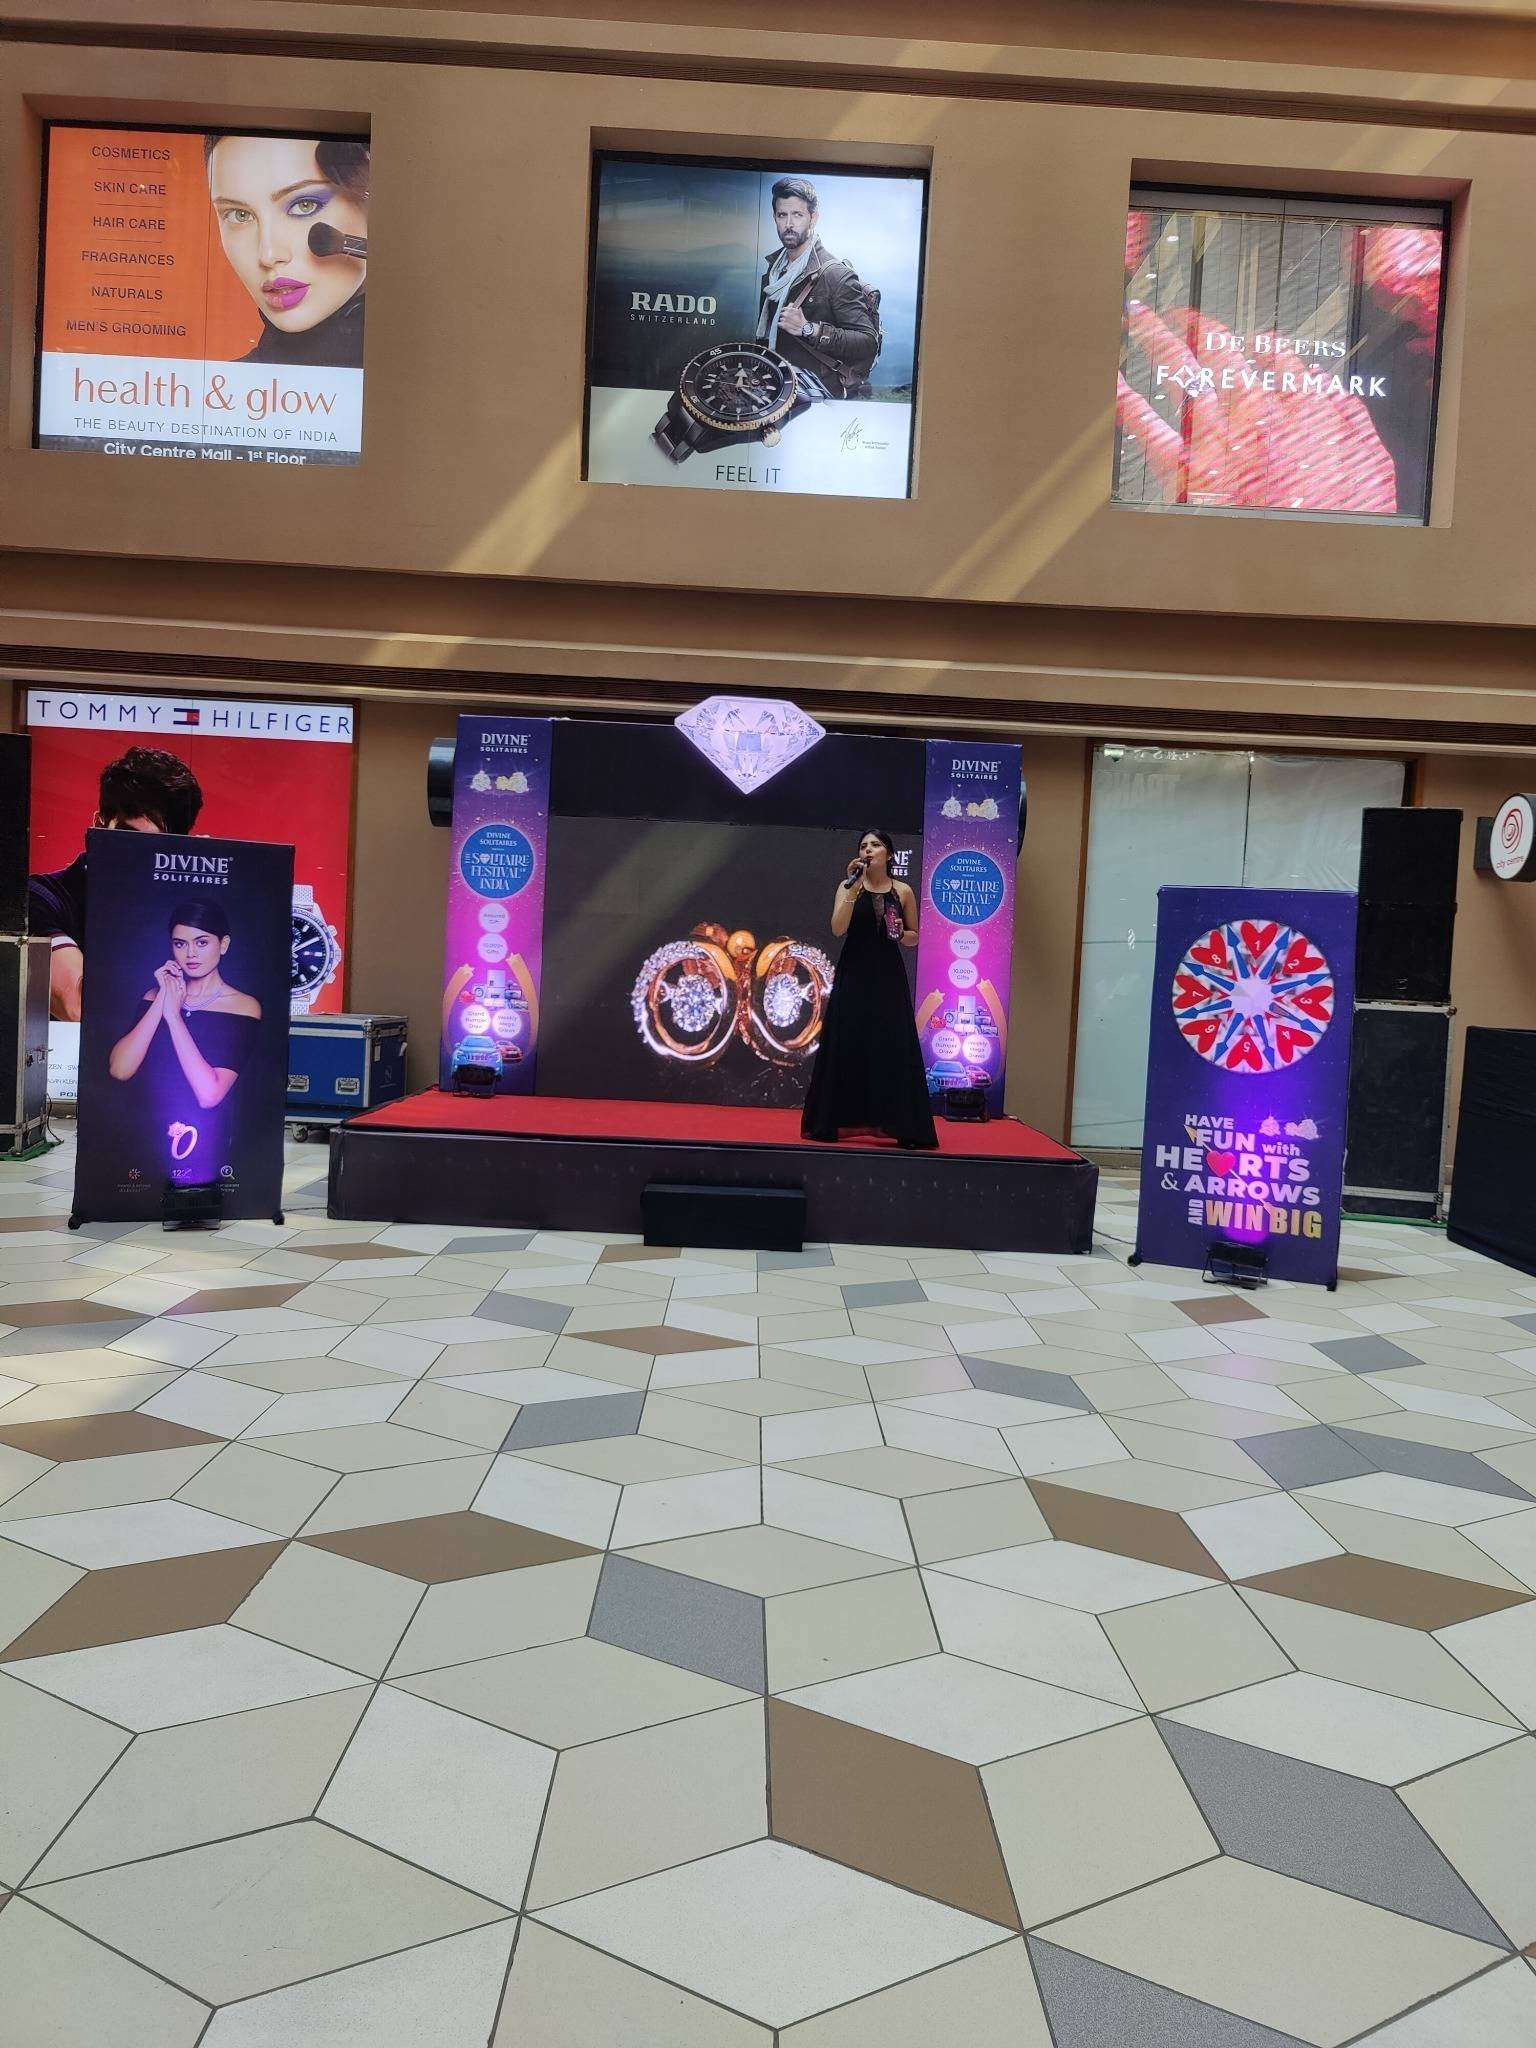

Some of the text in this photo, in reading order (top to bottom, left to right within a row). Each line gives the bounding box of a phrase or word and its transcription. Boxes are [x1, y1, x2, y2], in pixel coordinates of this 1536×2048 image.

[92, 146, 170, 161] COSMETICS
[94, 181, 166, 195] SKIN CARE
[93, 216, 166, 230] HAIR CARE
[81, 250, 175, 265] FRAGRANCES
[91, 286, 163, 300] NATURALS
[630, 291, 717, 315] RADO
[630, 313, 716, 326] SWITZERLAND
[66, 320, 186, 336] MEN'S GROOMING
[1205, 332, 1347, 358] DE BEERS
[74, 367, 337, 420] health & glow
[74, 418, 337, 442] THE BEAUTY DESTINATION OF INDIA
[104, 441, 136, 455] City
[140, 444, 197, 459] Centre
[201, 448, 232, 460] Mall
[266, 451, 307, 465] Floor
[716, 465, 781, 484] FEEL IT
[36, 700, 351, 734] TOMMY HILFIGER
[481, 733, 529, 746] DIVINE
[480, 746, 528, 754] SOLITAIRES
[952, 759, 999, 773] DIVINE
[951, 772, 999, 781] SOLITAIRES
[154, 853, 229, 873] DIVINE
[472, 852, 530, 867] SLITAIRE
[957, 858, 982, 866] DIVINE
[471, 865, 521, 879] FESTIVAL
[950, 865, 988, 873] SOLITAIRES
[153, 873, 229, 885] SOLITAIRES
[480, 878, 510, 891] INDIA
[942, 878, 1000, 893] SLITAIRE
[942, 891, 991, 905] FESTIVAL
[951, 904, 980, 917] INDIA
[1255, 941, 1261, 950] 1
[1211, 954, 1221, 964] 8
[1288, 960, 1300, 970] 2
[1192, 990, 1204, 998] 7
[1300, 997, 1312, 1005] 3
[1204, 1024, 1216, 1033] 6
[1282, 1031, 1290, 1040] 4
[1243, 1042, 1251, 1052] 5
[1185, 1114, 1234, 1129] HAVE
[1196, 1129, 1256, 1151] FUN
[1262, 1142, 1300, 1156] with
[1155, 1145, 1310, 1182] HERTS
[1160, 1172, 1321, 1206] & ARROWS
[1188, 1199, 1322, 1239] AND WIN BIG
